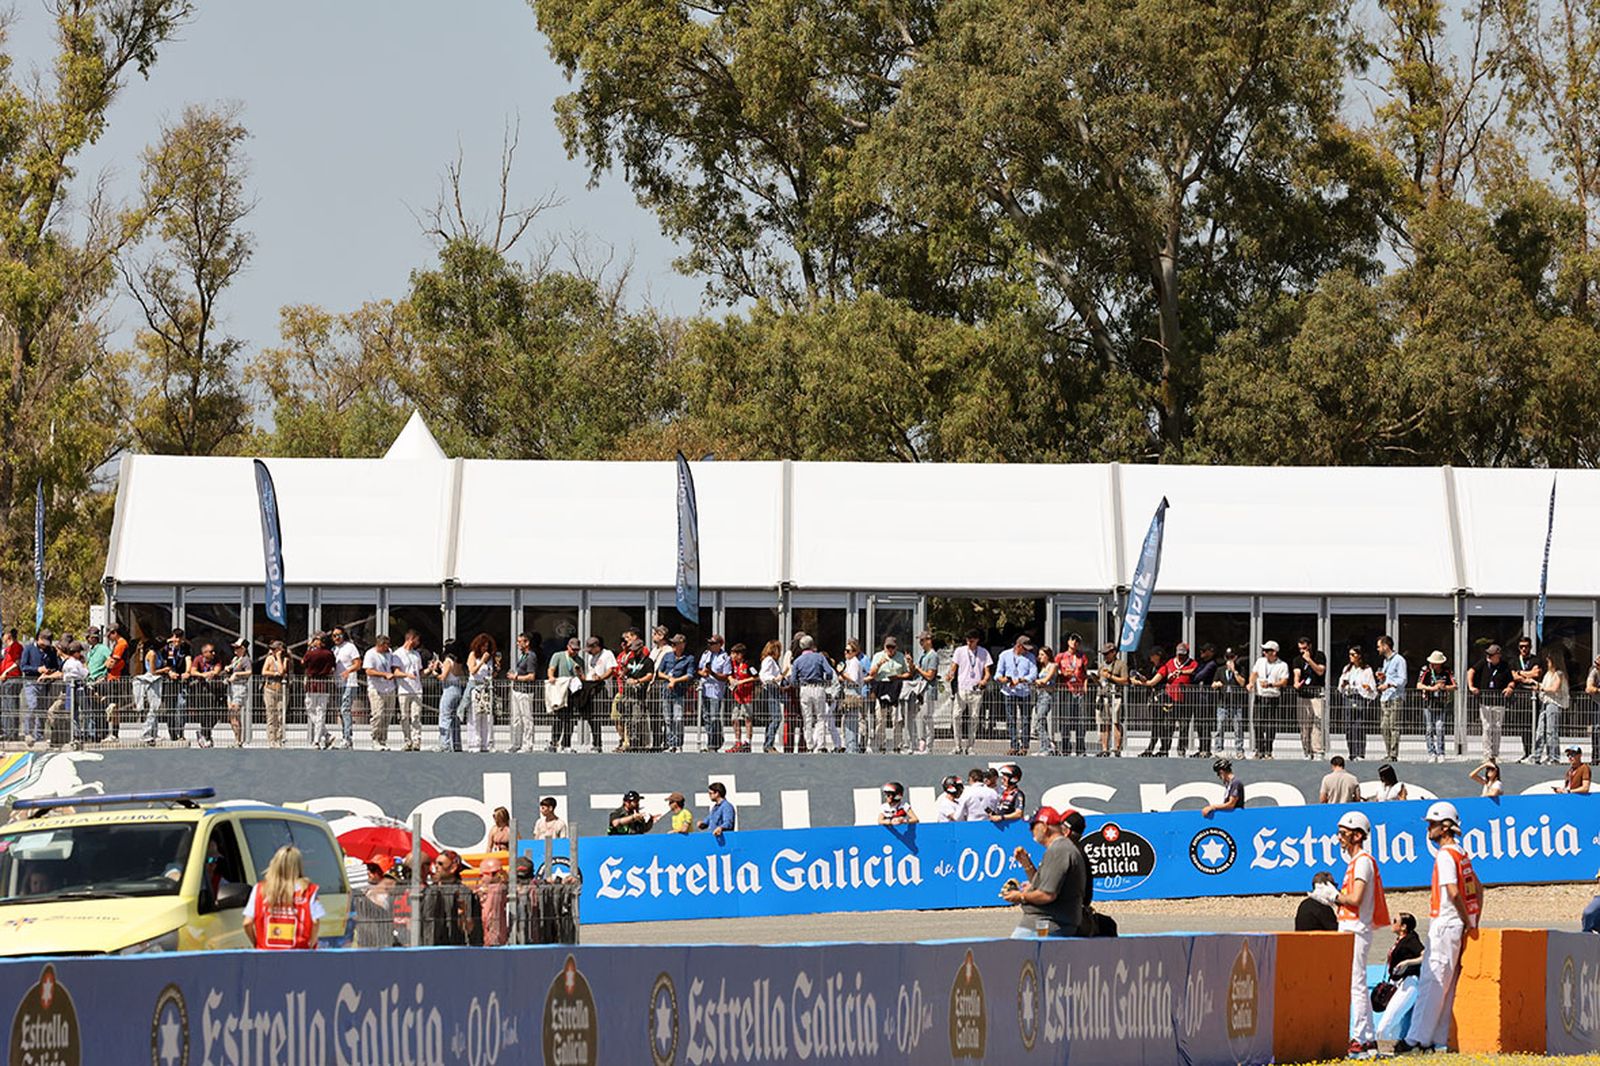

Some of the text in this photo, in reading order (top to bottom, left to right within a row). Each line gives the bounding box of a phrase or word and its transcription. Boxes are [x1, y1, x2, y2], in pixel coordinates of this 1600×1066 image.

[1084, 842, 1140, 858] Estrella
[1250, 823, 1418, 870] Estrla
[596, 855, 762, 899] Estrella
[771, 845, 923, 892] Galicia
[958, 844, 1006, 882] 0,0
[955, 988, 981, 1017] Estrella
[1043, 963, 1111, 1044] Estrella
[1113, 959, 1173, 1040] Galicia
[1231, 975, 1254, 1001] Estrella
[200, 987, 326, 1066] Estrella
[334, 982, 444, 1066] Galicia
[551, 999, 589, 1031] Estrella
[685, 976, 787, 1065] Estrella
[791, 971, 878, 1060] Galicia
[1231, 1002, 1253, 1031] Galicia
[20, 1013, 70, 1051] Estrella
[552, 1032, 588, 1065] Galicia
[956, 1019, 980, 1049] Galicia
